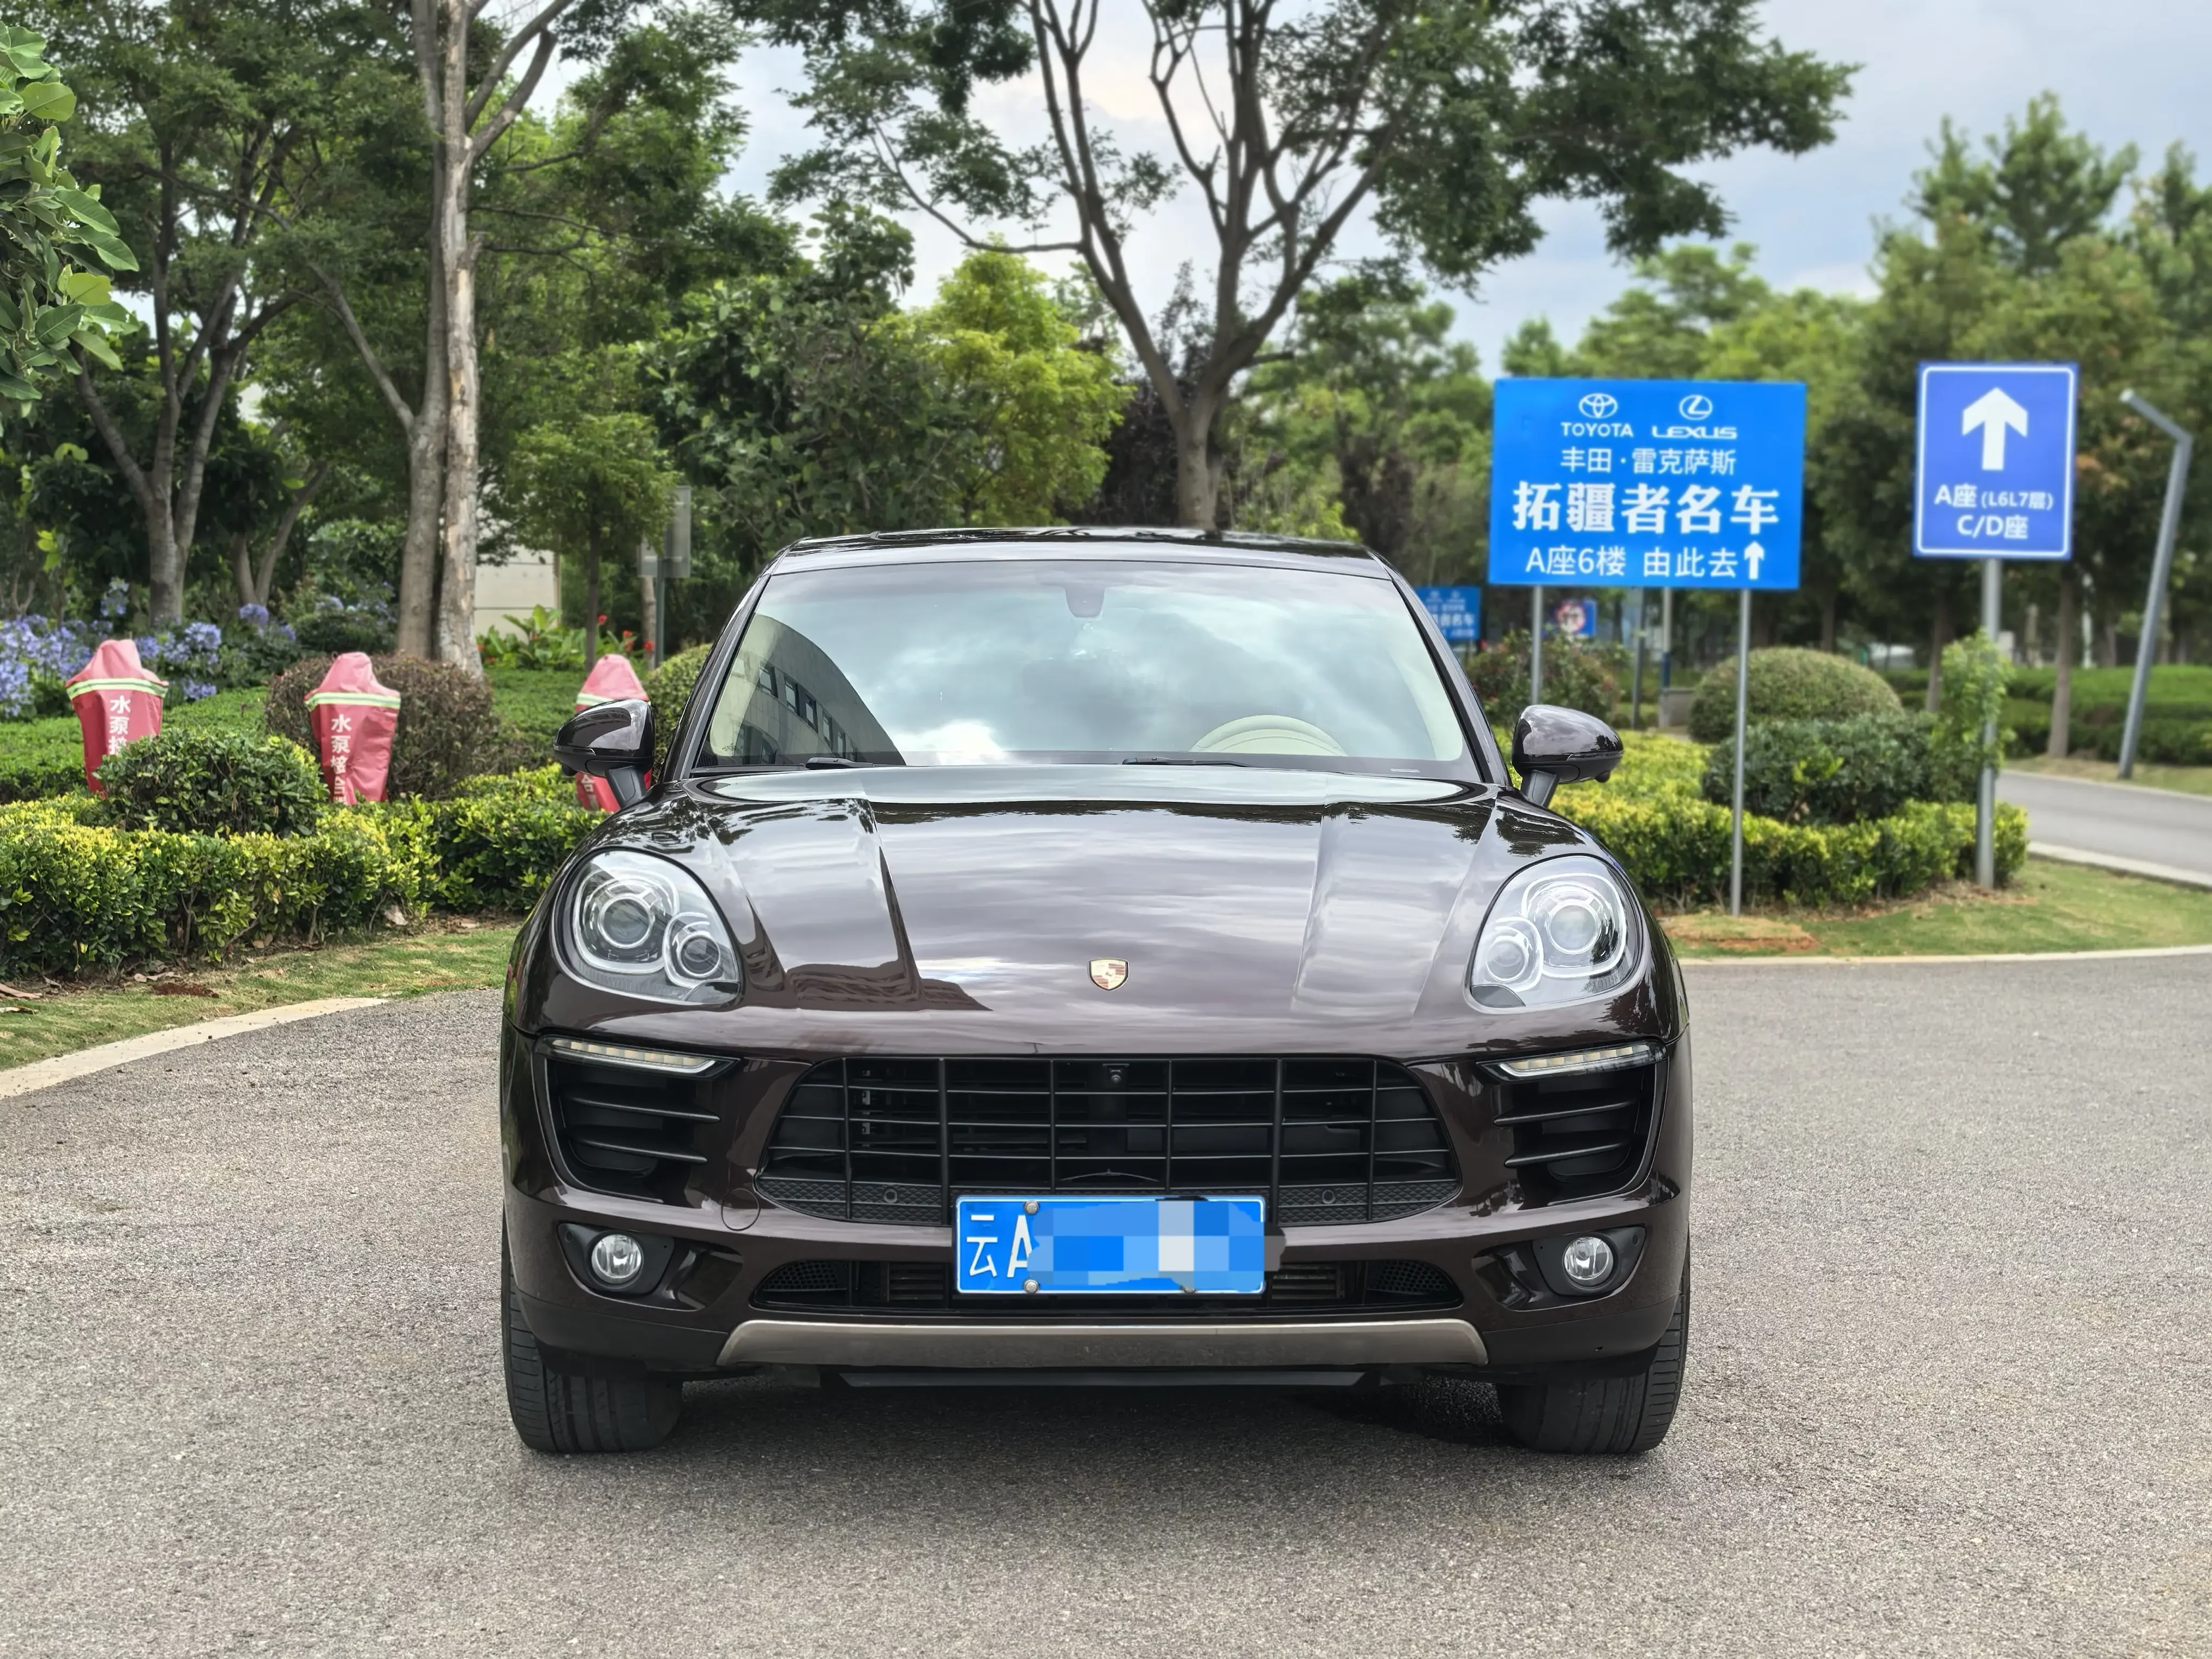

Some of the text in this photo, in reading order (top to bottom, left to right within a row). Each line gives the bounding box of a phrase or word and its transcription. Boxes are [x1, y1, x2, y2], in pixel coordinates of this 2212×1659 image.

[1561, 423, 1737, 440] TOYOTA LEXUS
[1513, 481, 1779, 535] 拓疆者名车
[1934, 483, 1978, 508] A座
[1957, 515, 2028, 539] C/D座
[1526, 547, 1738, 578] A座6楼 由此去
